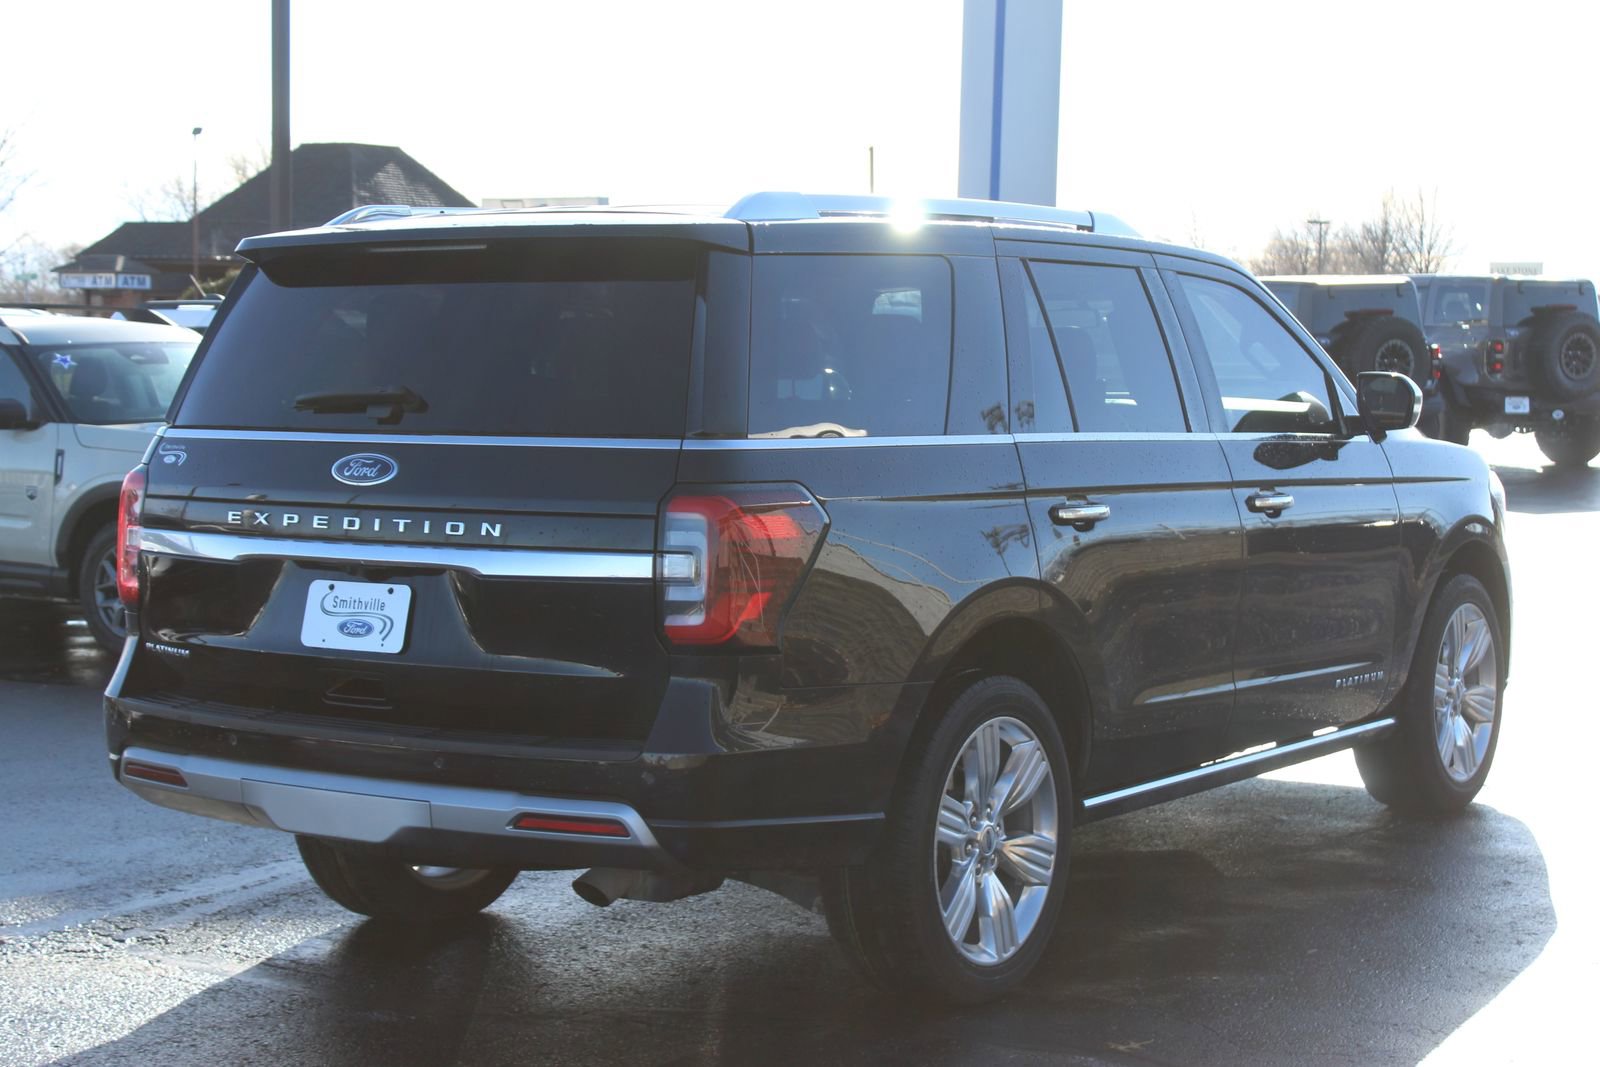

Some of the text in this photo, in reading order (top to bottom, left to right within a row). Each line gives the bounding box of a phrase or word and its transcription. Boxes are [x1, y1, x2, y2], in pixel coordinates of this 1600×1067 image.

[91, 275, 113, 286] ATM
[122, 275, 147, 287] ATM
[344, 459, 378, 478] Ford
[227, 510, 502, 537] EXPEDITION
[332, 595, 386, 612] Smithville
[343, 621, 369, 636] Ford
